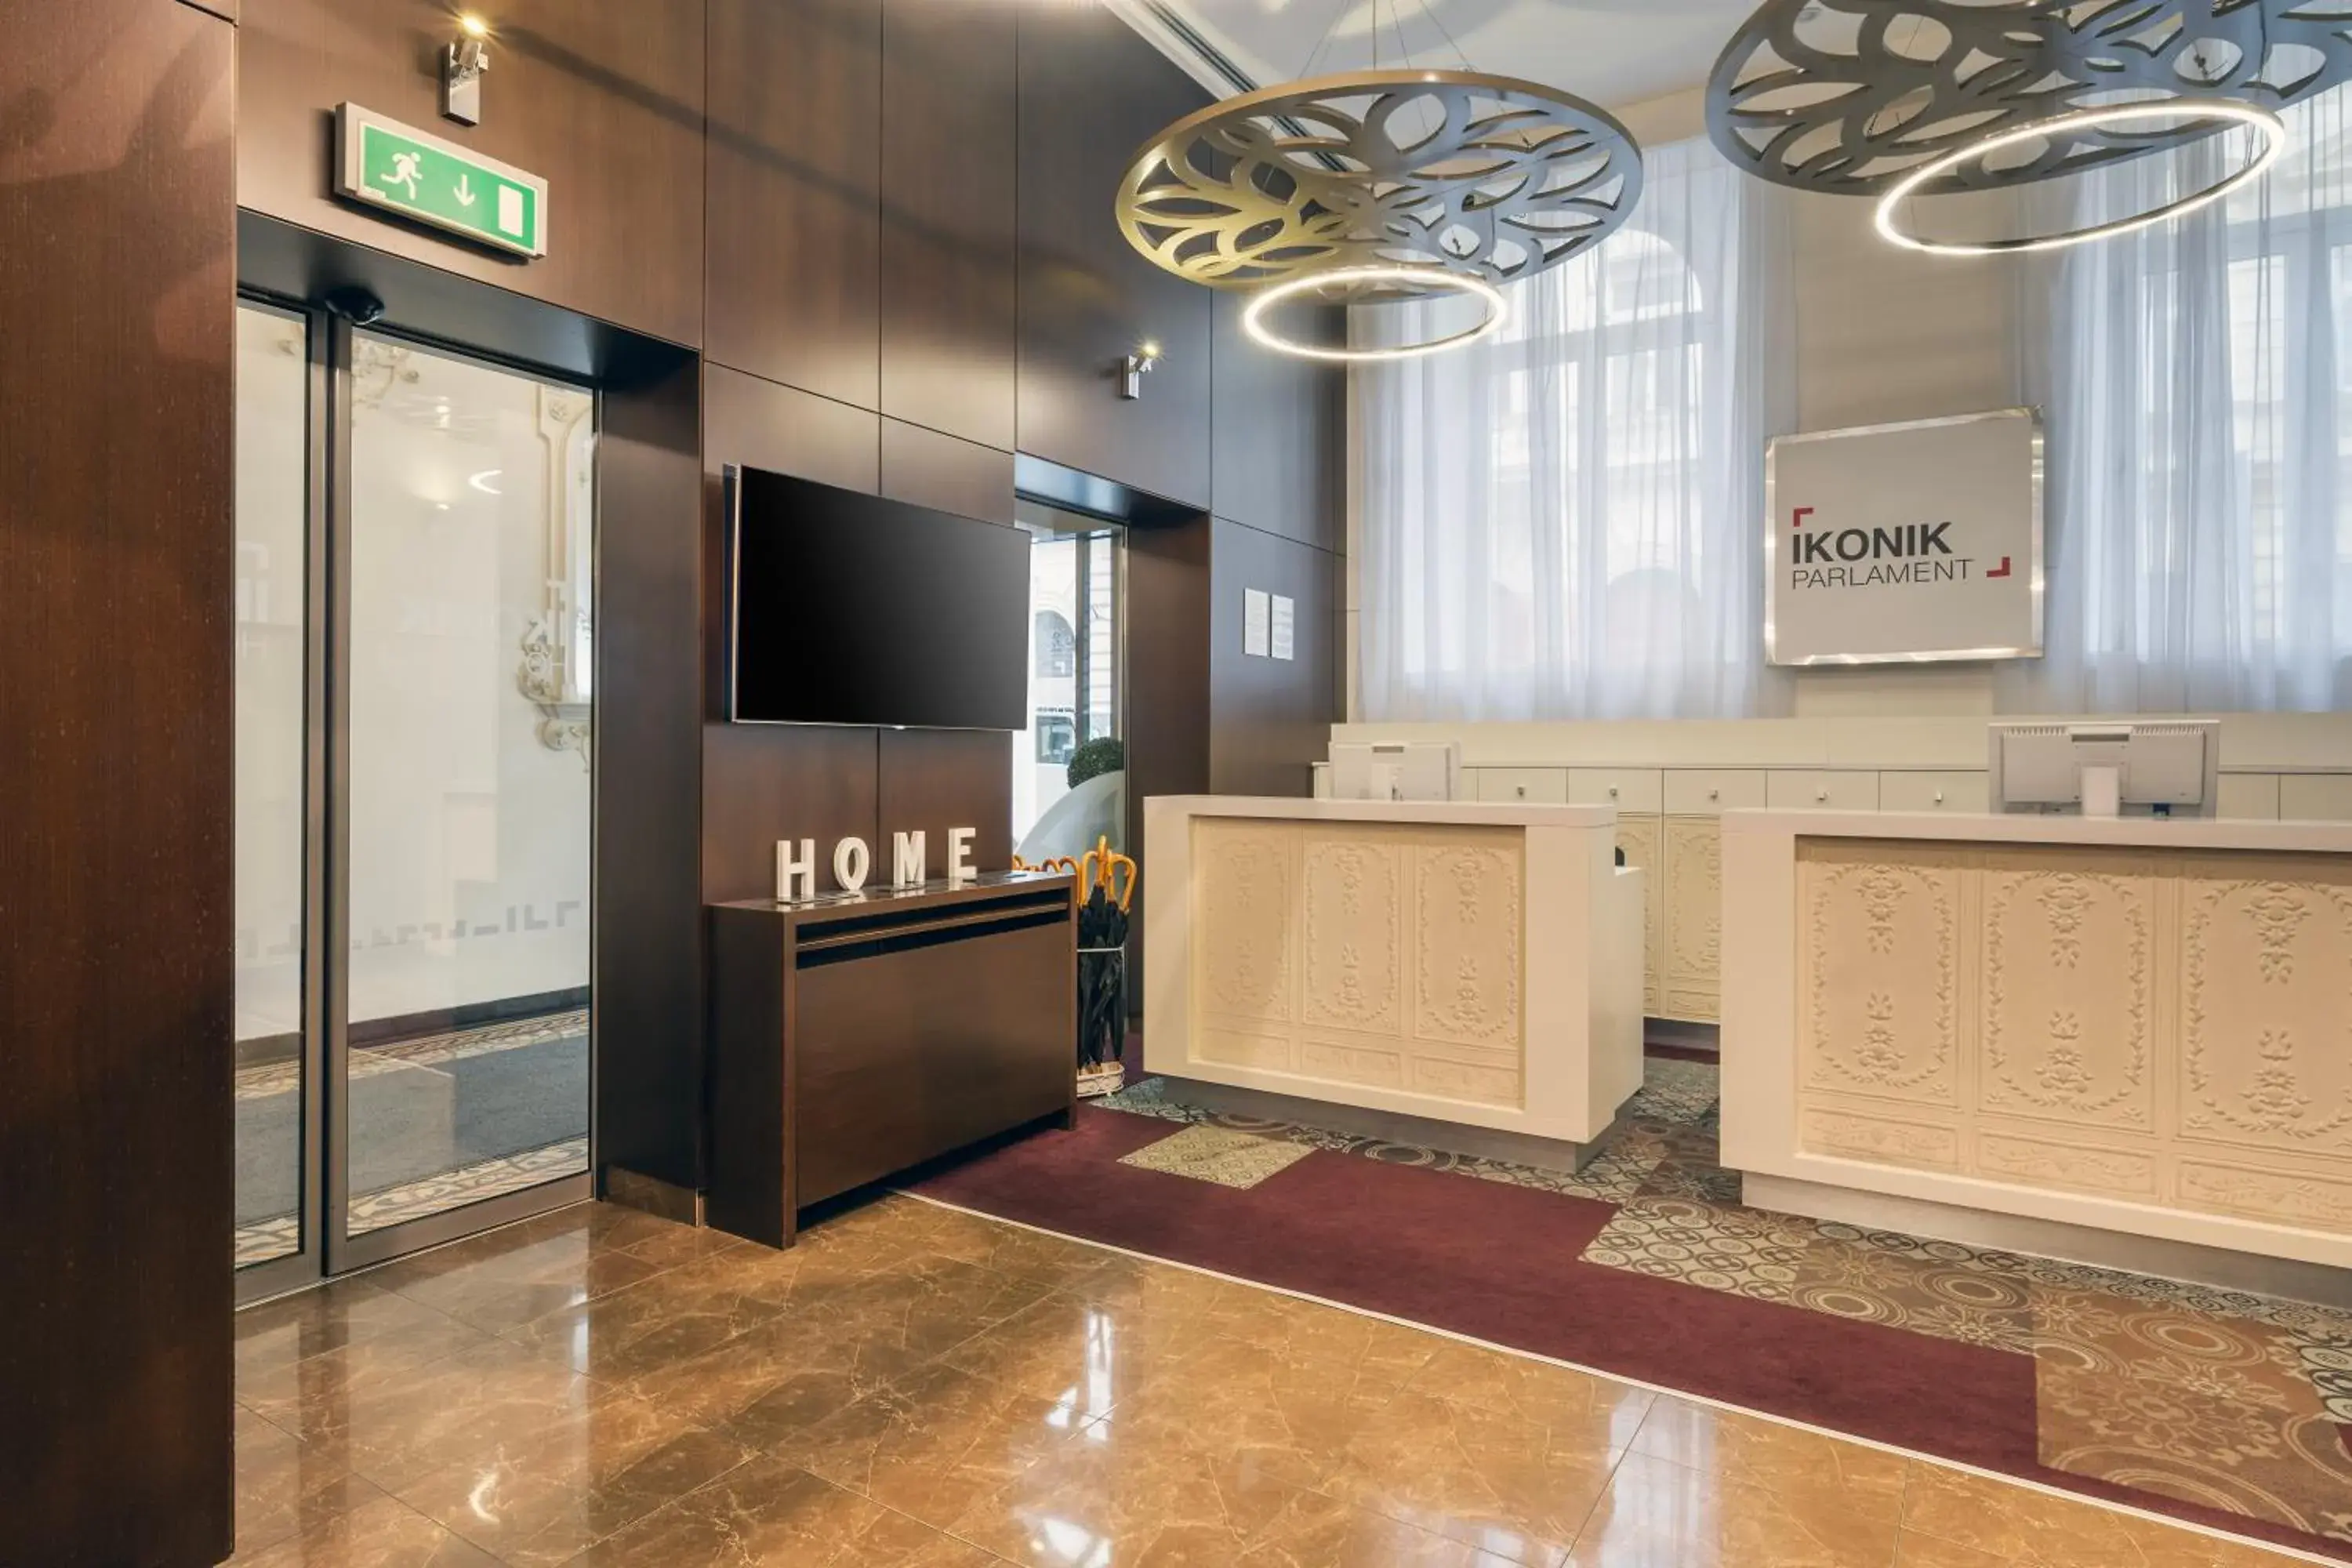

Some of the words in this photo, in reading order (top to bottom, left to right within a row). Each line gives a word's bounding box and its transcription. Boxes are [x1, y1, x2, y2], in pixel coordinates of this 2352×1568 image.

[1793, 522, 1953, 564] IKONIK
[1792, 558, 1975, 590] PARLAMENT
[777, 827, 978, 901] HOME
